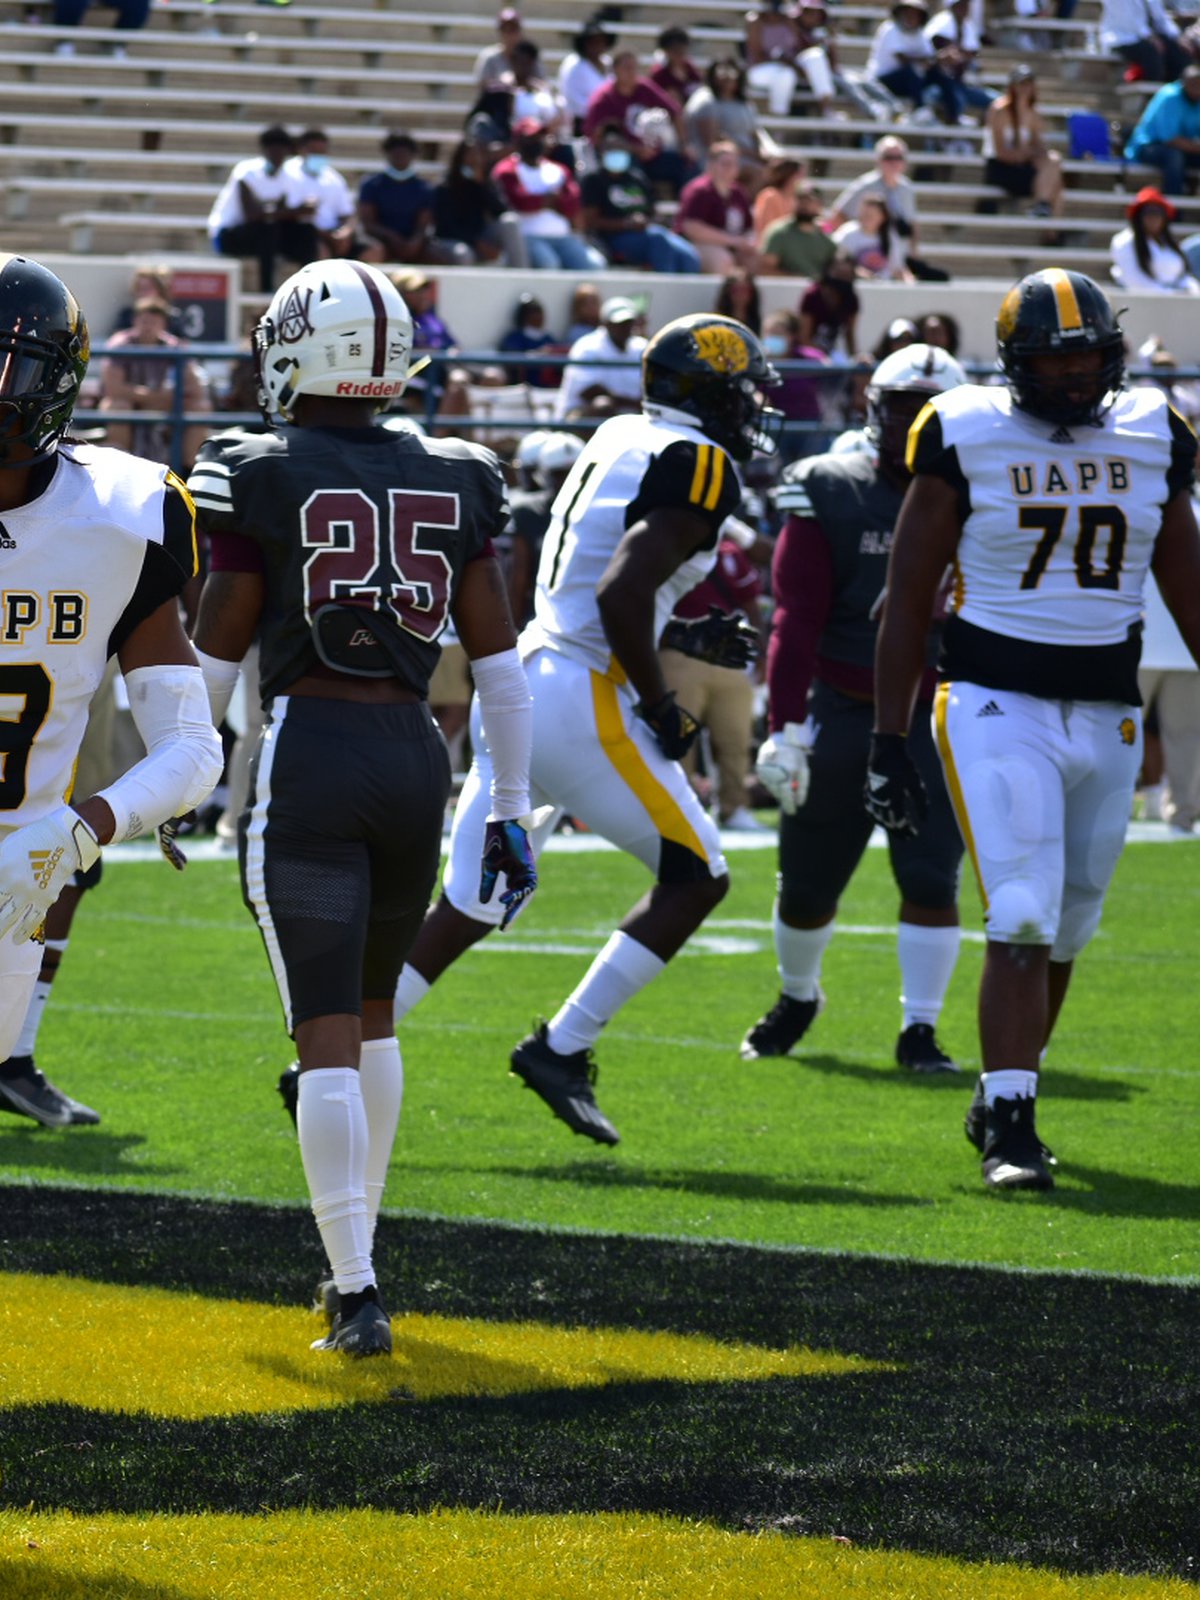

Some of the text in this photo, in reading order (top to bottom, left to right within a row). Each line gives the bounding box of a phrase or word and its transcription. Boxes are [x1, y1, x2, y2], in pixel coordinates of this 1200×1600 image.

[336, 381, 403, 397] Riddell
[1008, 458, 1130, 498] UAPB
[300, 488, 460, 643] 25
[1018, 505, 1129, 591] 70
[38, 846, 65, 890] adidas
